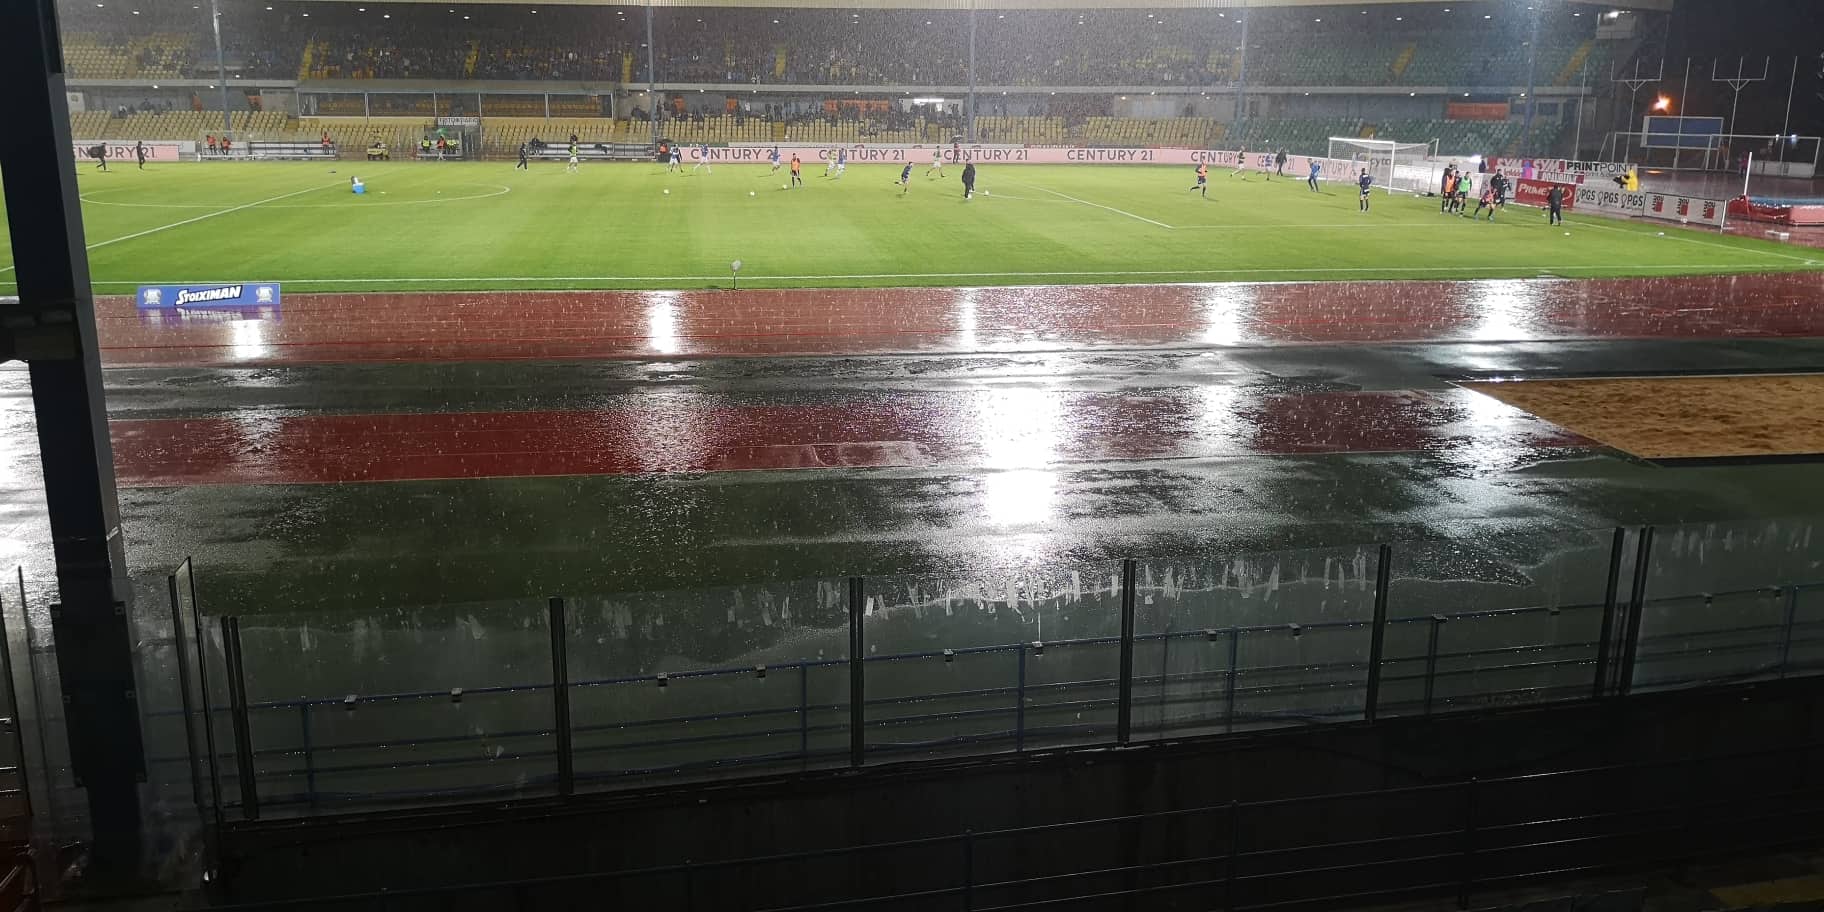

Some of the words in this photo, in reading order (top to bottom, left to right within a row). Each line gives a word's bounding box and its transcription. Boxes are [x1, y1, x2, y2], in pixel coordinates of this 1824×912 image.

[690, 149, 761, 160] CNTURY
[892, 149, 905, 160] 21
[943, 149, 1012, 160] CNTURY
[1016, 149, 1028, 160] 21
[1067, 149, 1136, 161] CENTURY
[1141, 150, 1153, 161] 21
[1518, 183, 1564, 198] PRIMET
[1581, 189, 1596, 201] PGS
[1603, 191, 1620, 204] PGS
[1627, 194, 1644, 207] PGS
